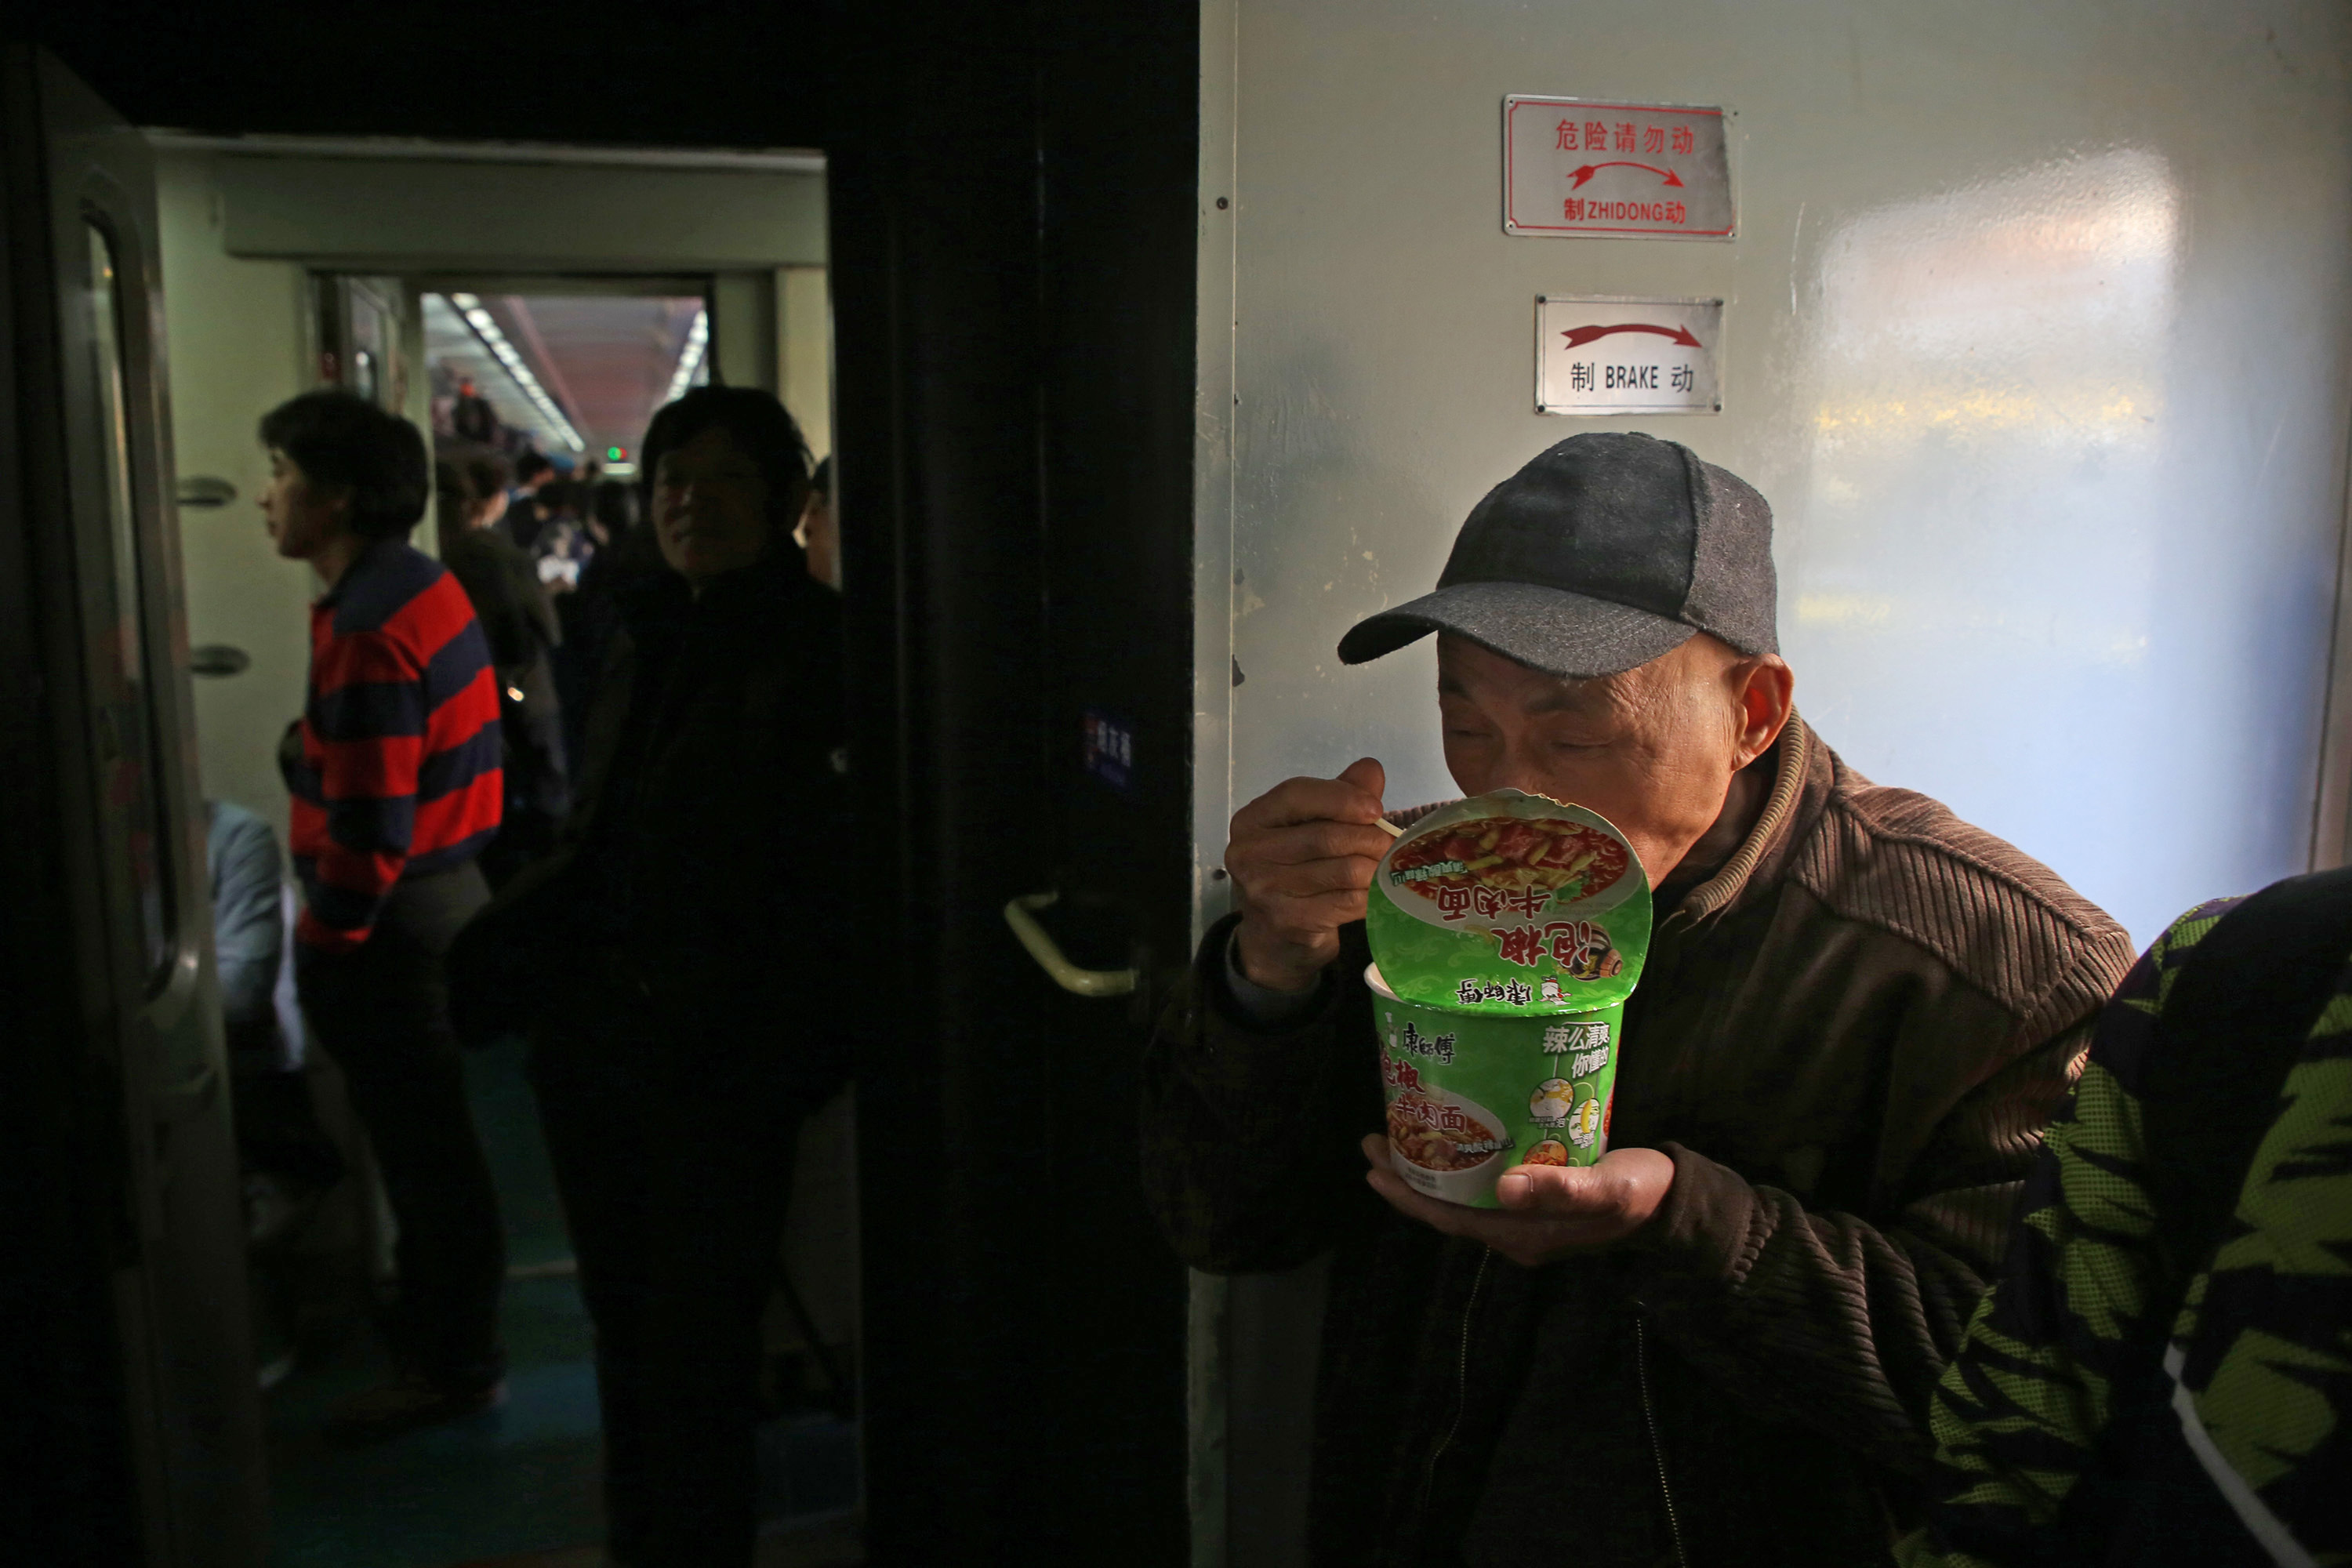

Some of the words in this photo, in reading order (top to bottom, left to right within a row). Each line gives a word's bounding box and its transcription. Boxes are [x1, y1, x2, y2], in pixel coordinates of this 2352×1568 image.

[1555, 118, 1693, 154] 危险请勿动
[1570, 361, 1595, 392] 制
[1606, 365, 1658, 388] BRAKE
[1670, 364, 1693, 392] 动
[1437, 885, 1552, 921] 牛肉面
[1490, 920, 1592, 967] 泡椒
[1543, 1024, 1610, 1054] 辣么清爽
[1571, 1045, 1609, 1079] 你懂的
[1395, 1095, 1468, 1134] 牛肉面
